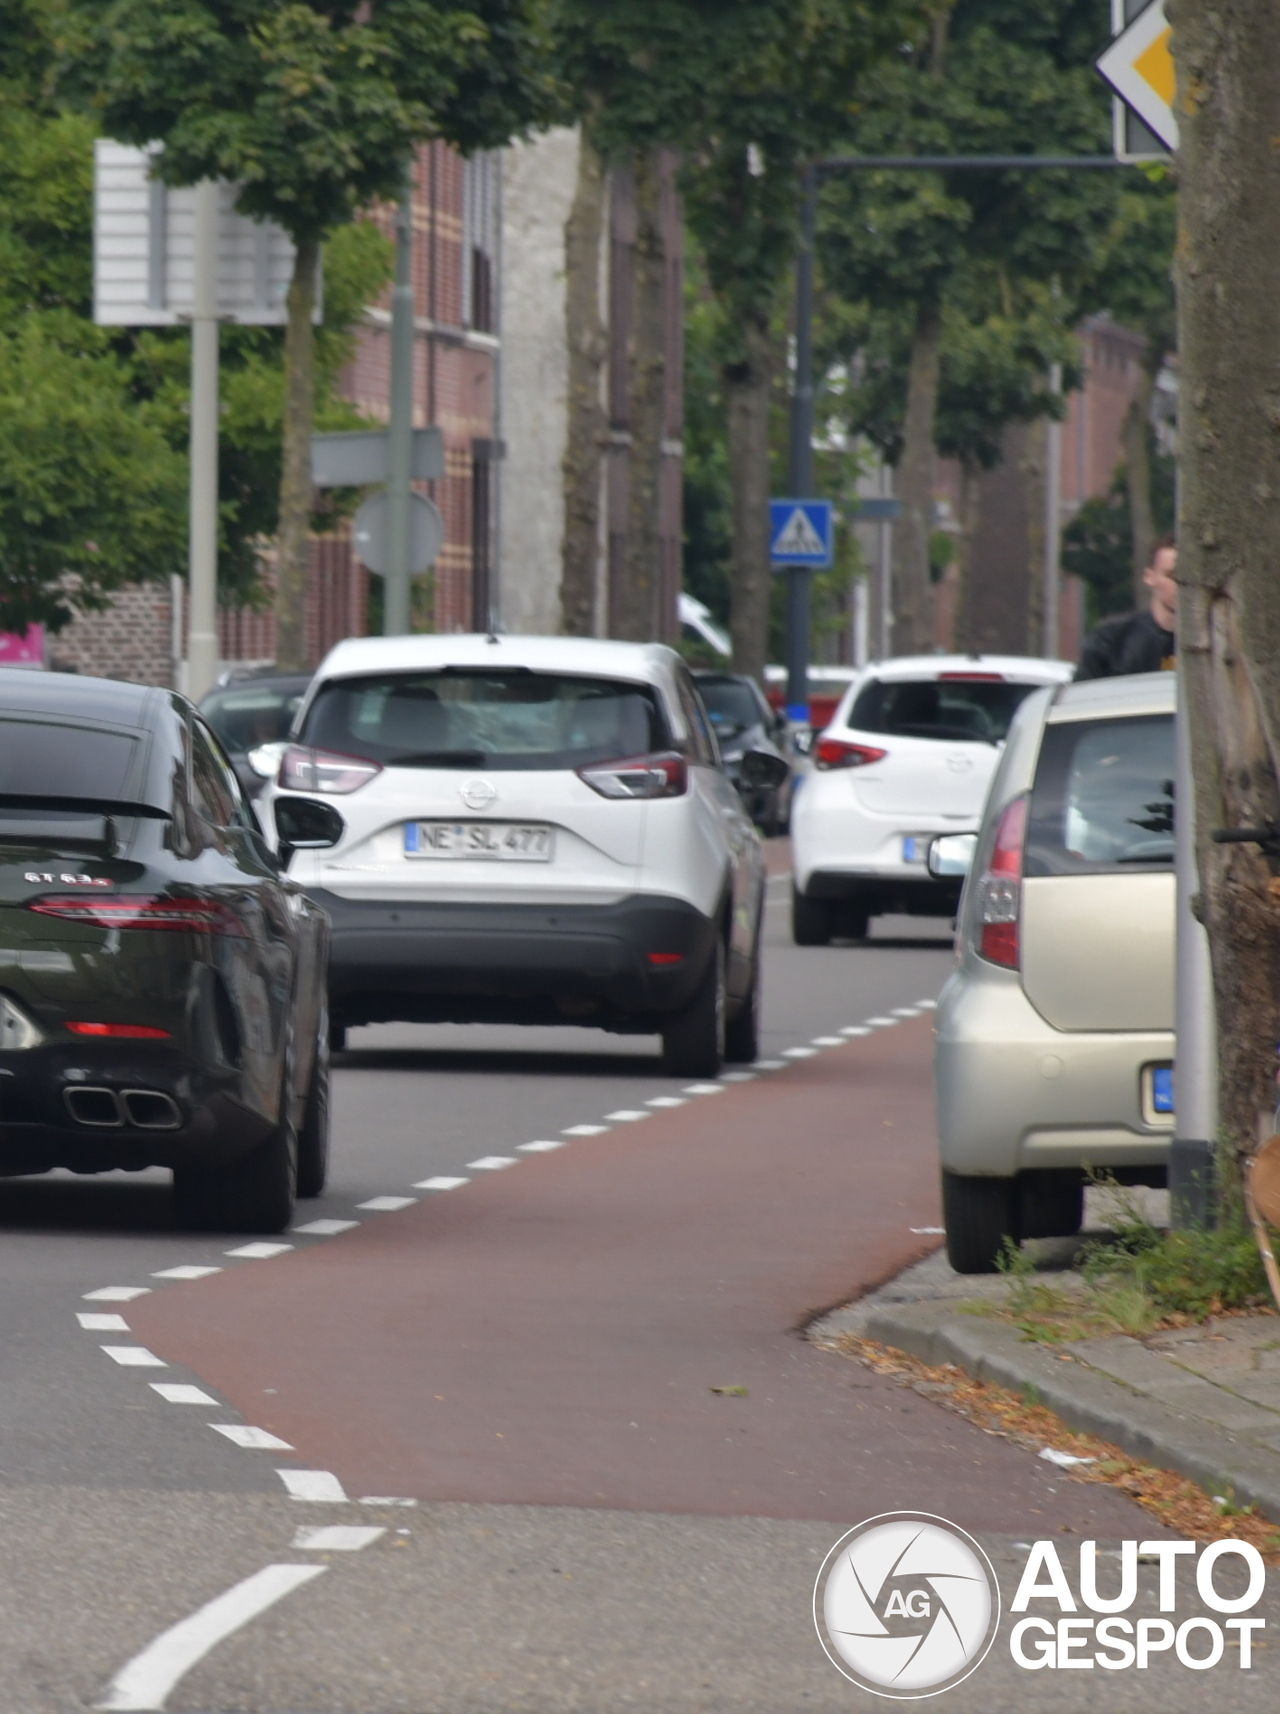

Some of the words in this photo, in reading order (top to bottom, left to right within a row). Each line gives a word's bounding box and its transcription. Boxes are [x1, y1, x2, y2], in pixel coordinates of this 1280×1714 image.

[420, 826, 451, 850] NE
[465, 826, 499, 851] SL
[502, 827, 549, 852] 477
